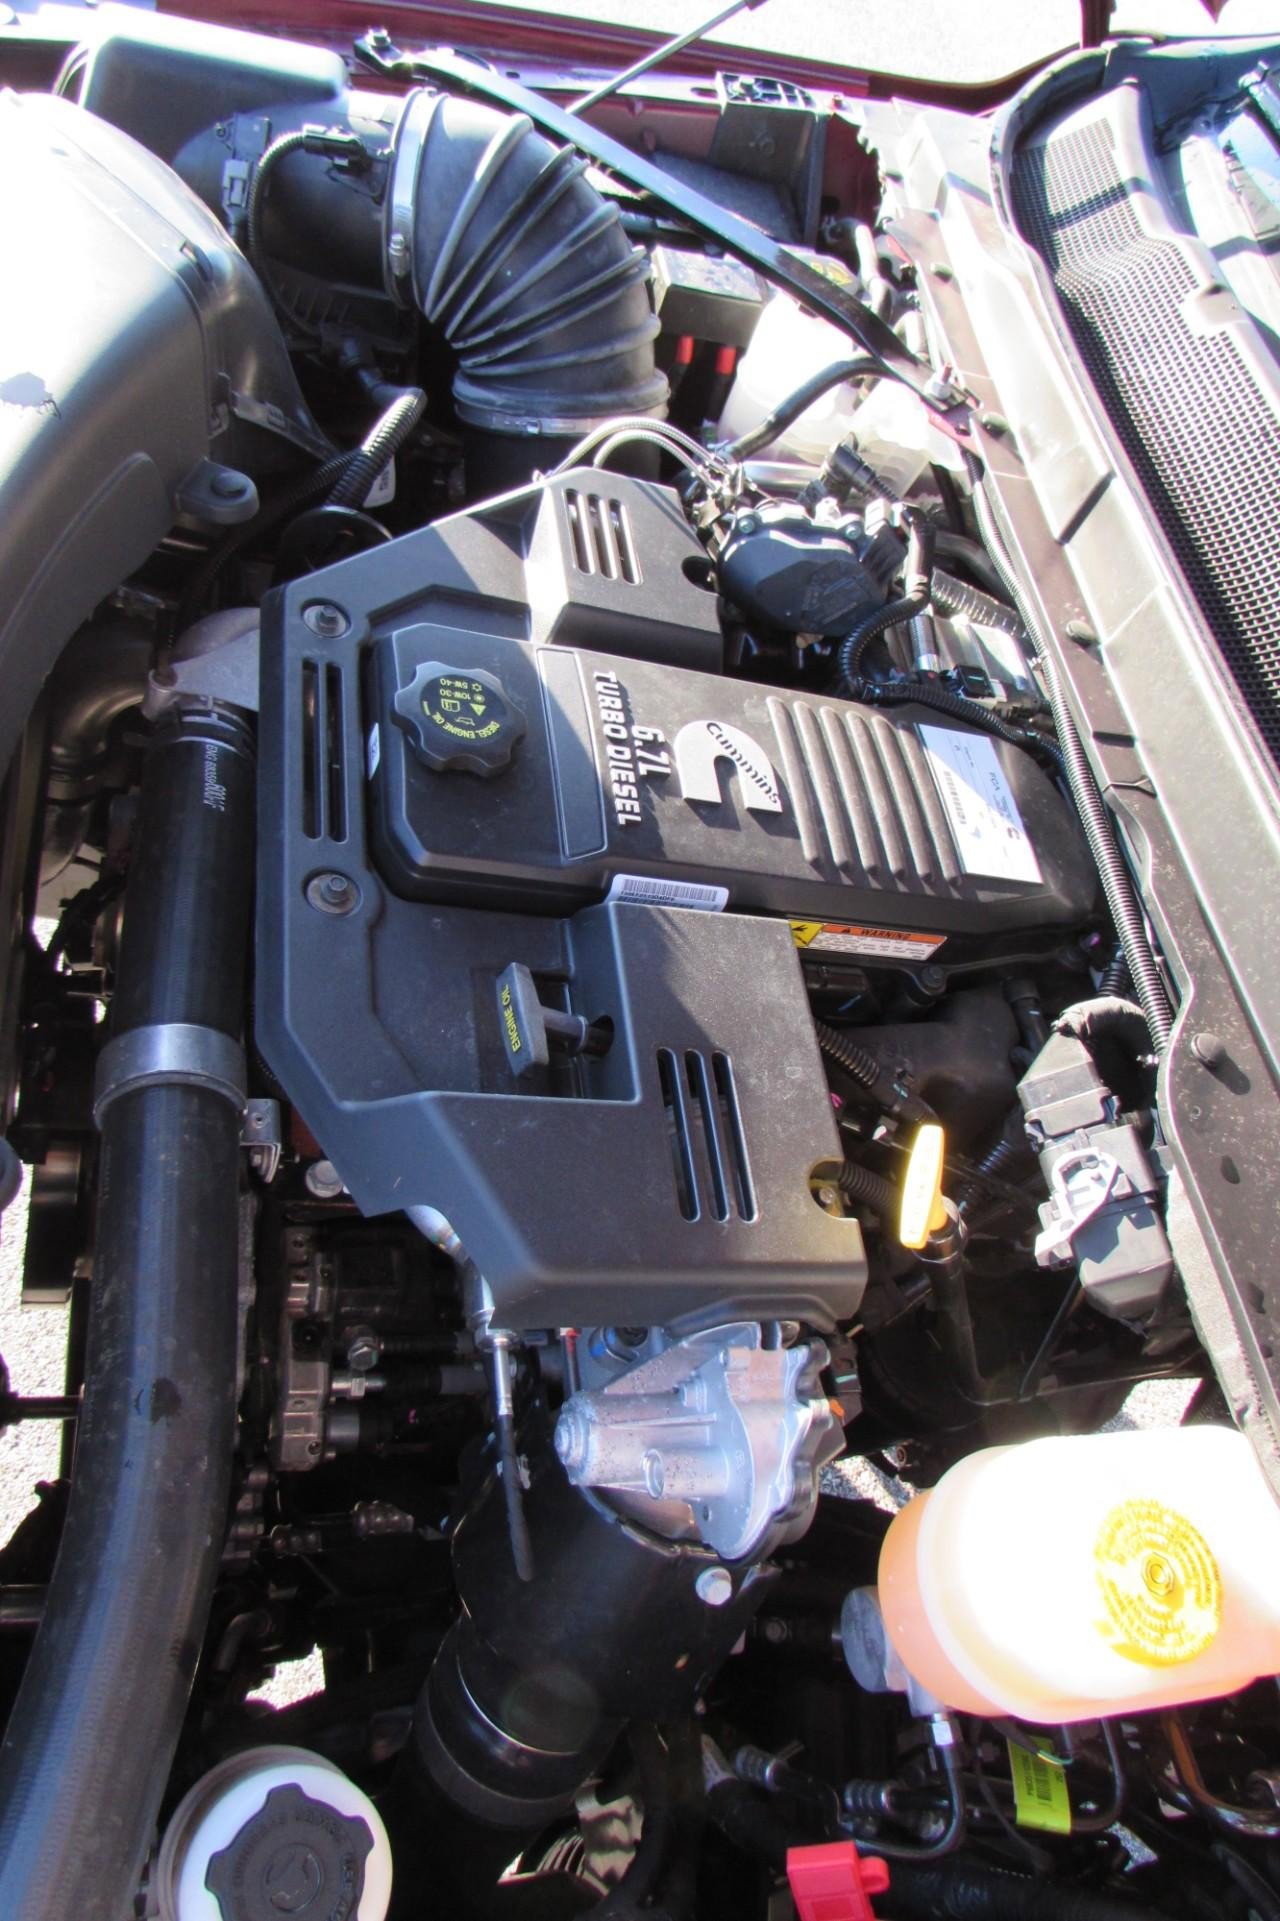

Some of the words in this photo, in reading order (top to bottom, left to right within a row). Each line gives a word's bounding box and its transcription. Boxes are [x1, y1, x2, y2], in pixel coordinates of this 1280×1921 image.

[440, 678, 468, 689] 5W-40
[440, 688, 471, 700] 10W-30
[593, 671, 629, 740] TURBO
[431, 711, 445, 724] OIL
[443, 722, 475, 738] ENGINE
[631, 724, 671, 776] 6.7L
[706, 721, 778, 804] Cummins
[606, 744, 642, 825] DIESEL
[860, 928, 911, 940] WARNING
[501, 984, 511, 1006] OIL
[504, 1005, 521, 1052] ENGINE
